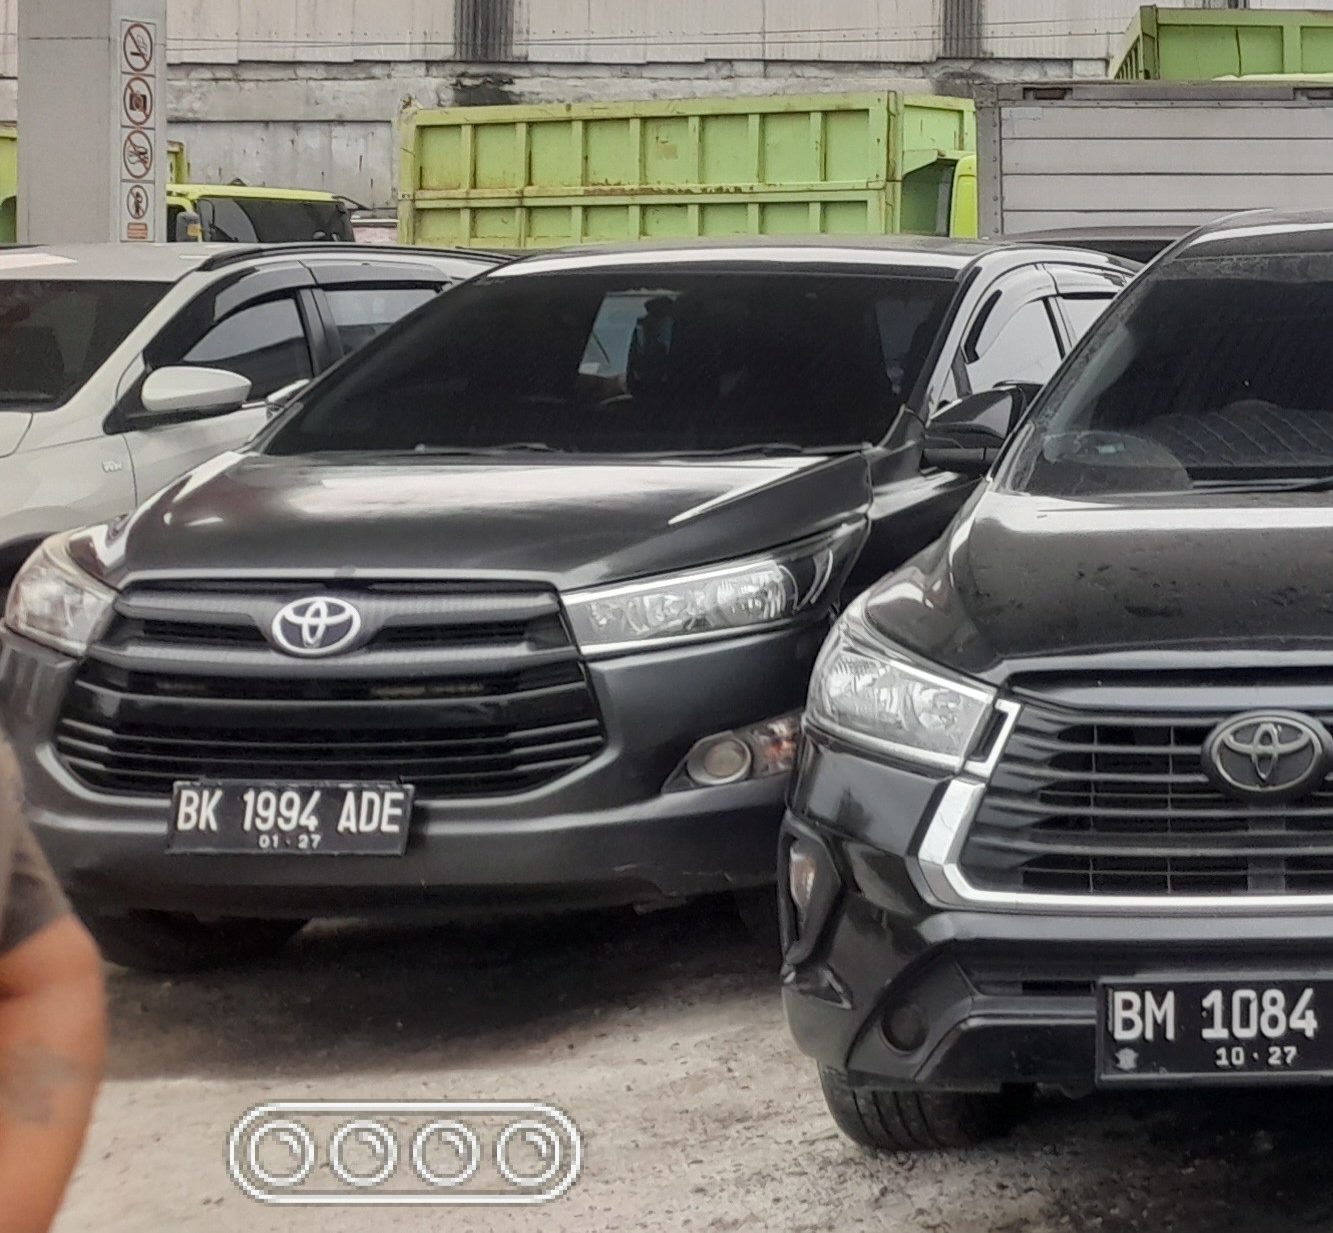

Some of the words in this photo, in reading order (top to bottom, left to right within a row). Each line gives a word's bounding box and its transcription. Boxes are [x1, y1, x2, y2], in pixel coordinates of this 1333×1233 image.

[177, 789, 223, 831] BK
[242, 788, 321, 832] 1994
[337, 790, 405, 833] ADE
[1113, 989, 1175, 1041] BM
[1201, 988, 1318, 1040] 1084
